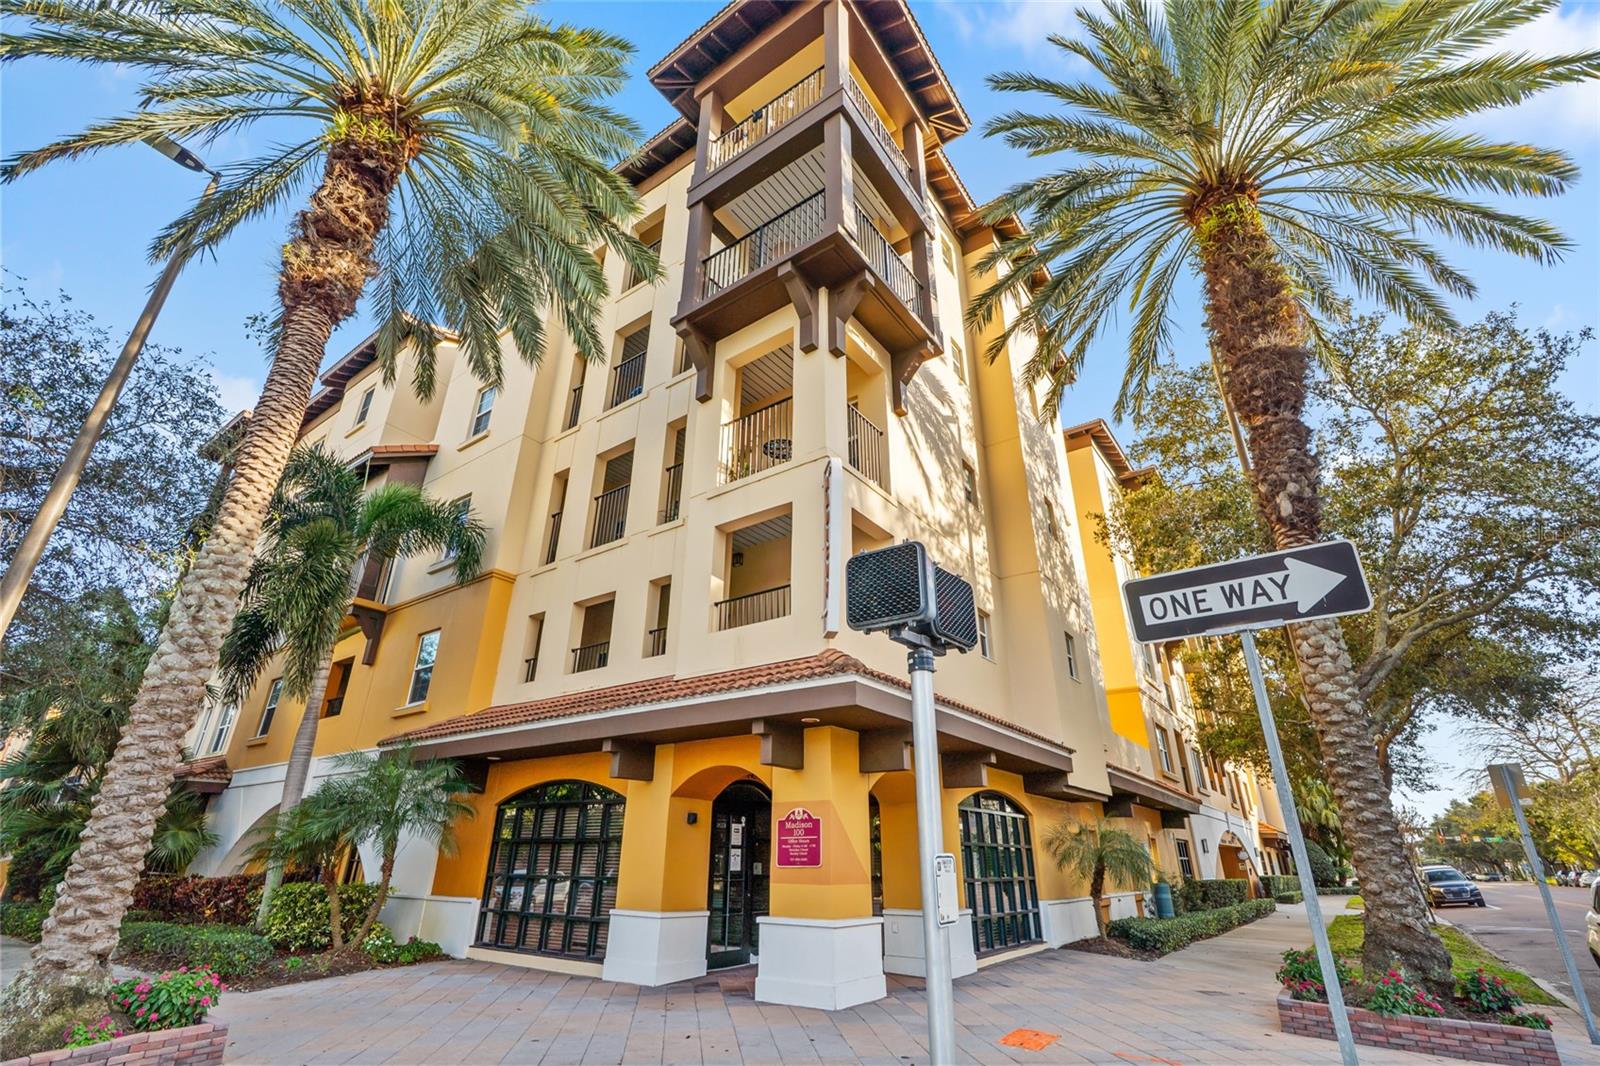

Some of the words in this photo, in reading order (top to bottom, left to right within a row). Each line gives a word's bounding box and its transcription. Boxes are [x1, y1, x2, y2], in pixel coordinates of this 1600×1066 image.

[1150, 589, 1212, 620] ONE
[1220, 574, 1290, 609] WAY
[785, 821, 813, 829] Madison
